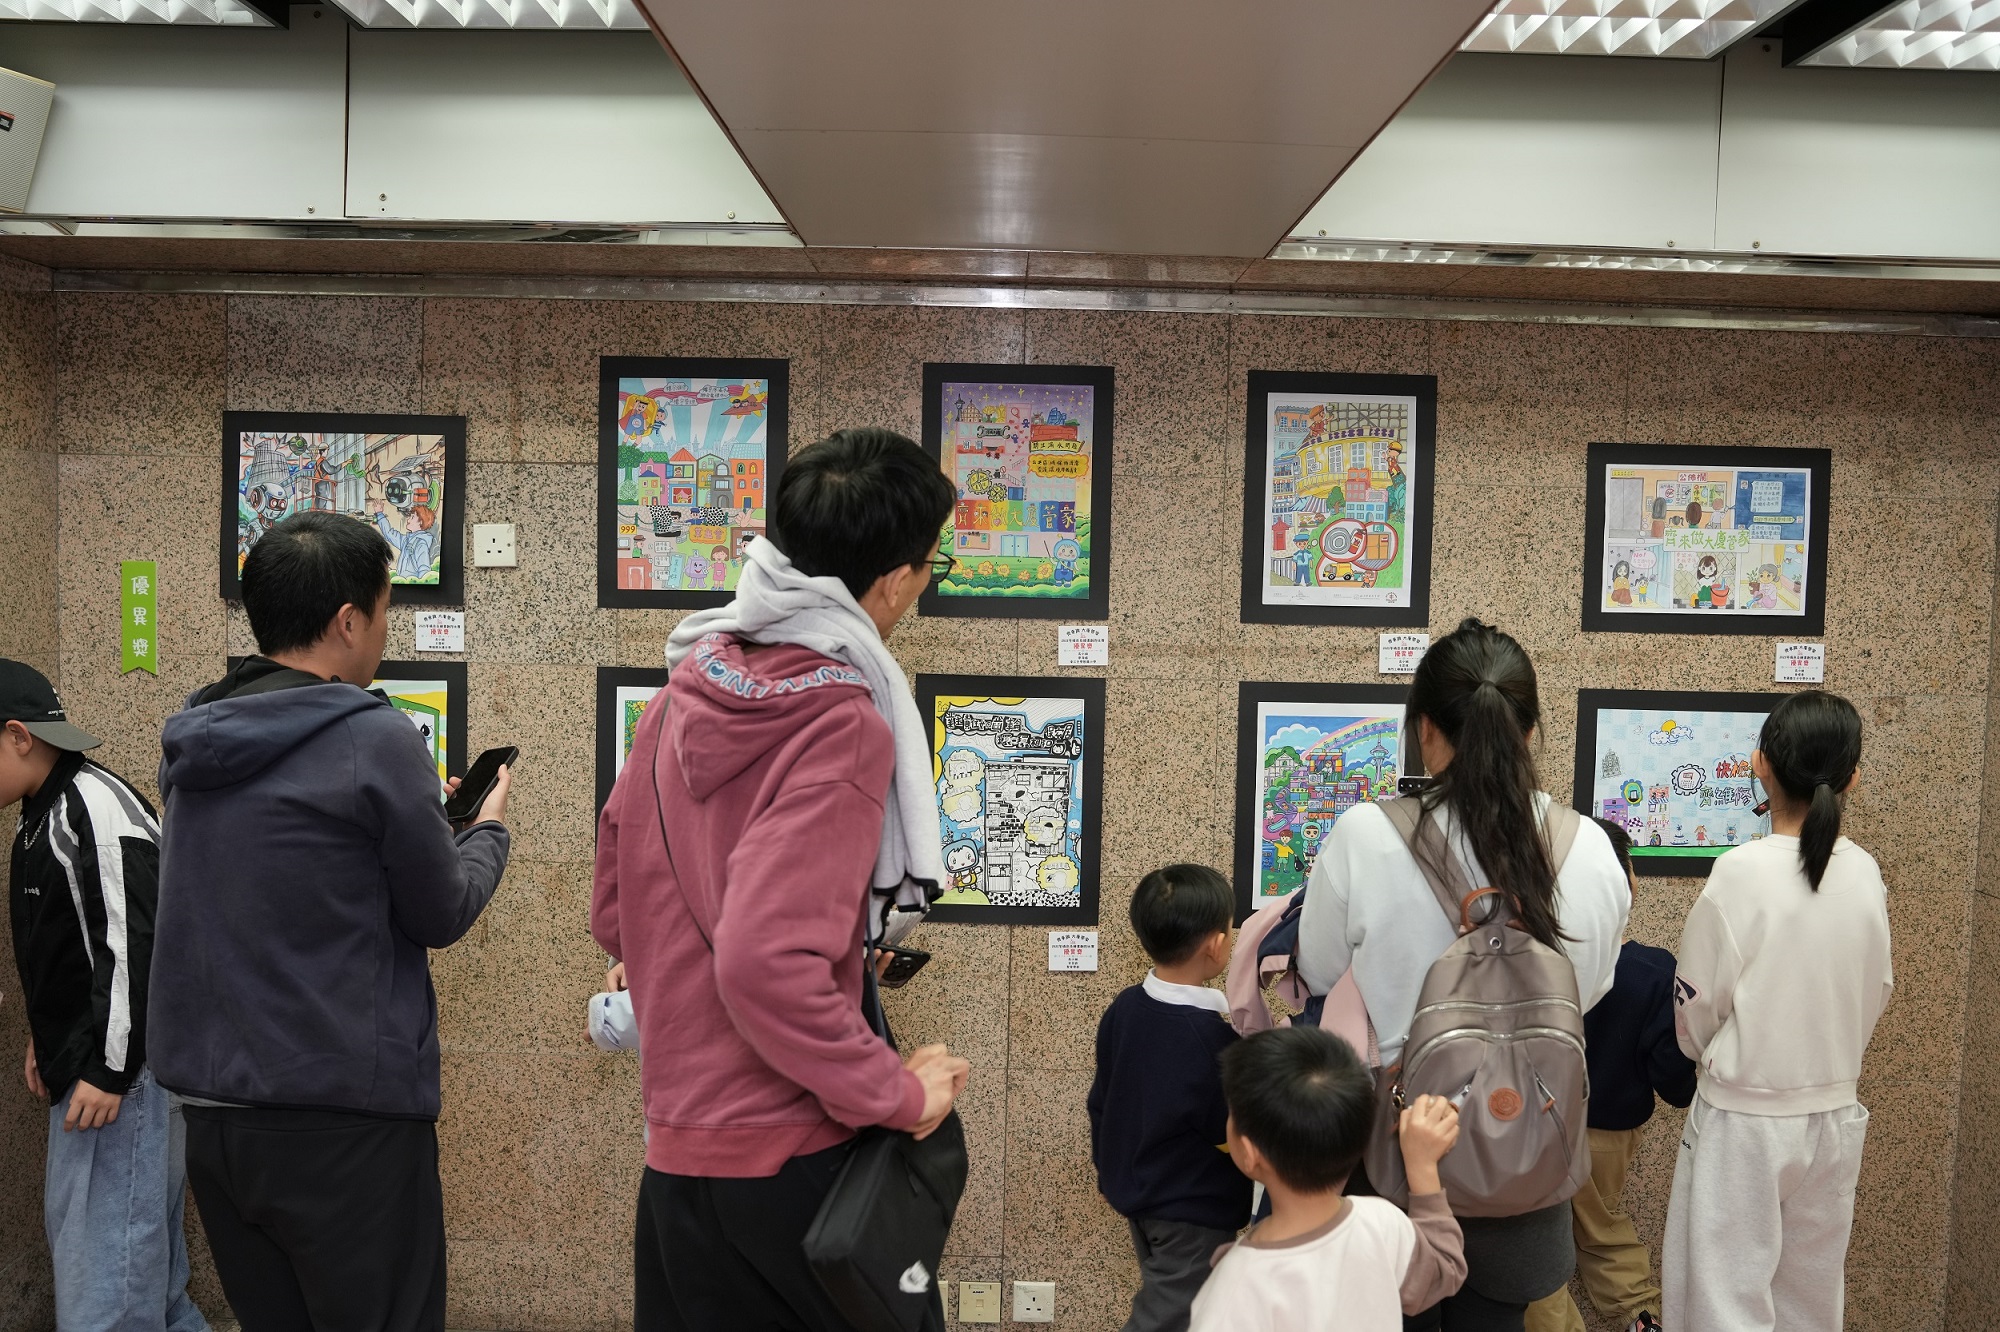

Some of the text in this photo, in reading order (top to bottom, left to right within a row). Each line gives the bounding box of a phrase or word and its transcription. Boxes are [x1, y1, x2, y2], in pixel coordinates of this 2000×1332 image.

[957, 502, 1076, 529] 齊來做大廈管家
[620, 525, 636, 534] 999
[1665, 529, 1750, 550] 齊來做大廈管家
[131, 575, 150, 658] 優異獎
[777, 664, 872, 694] RNITY
[1716, 755, 1757, 779] 快檢
